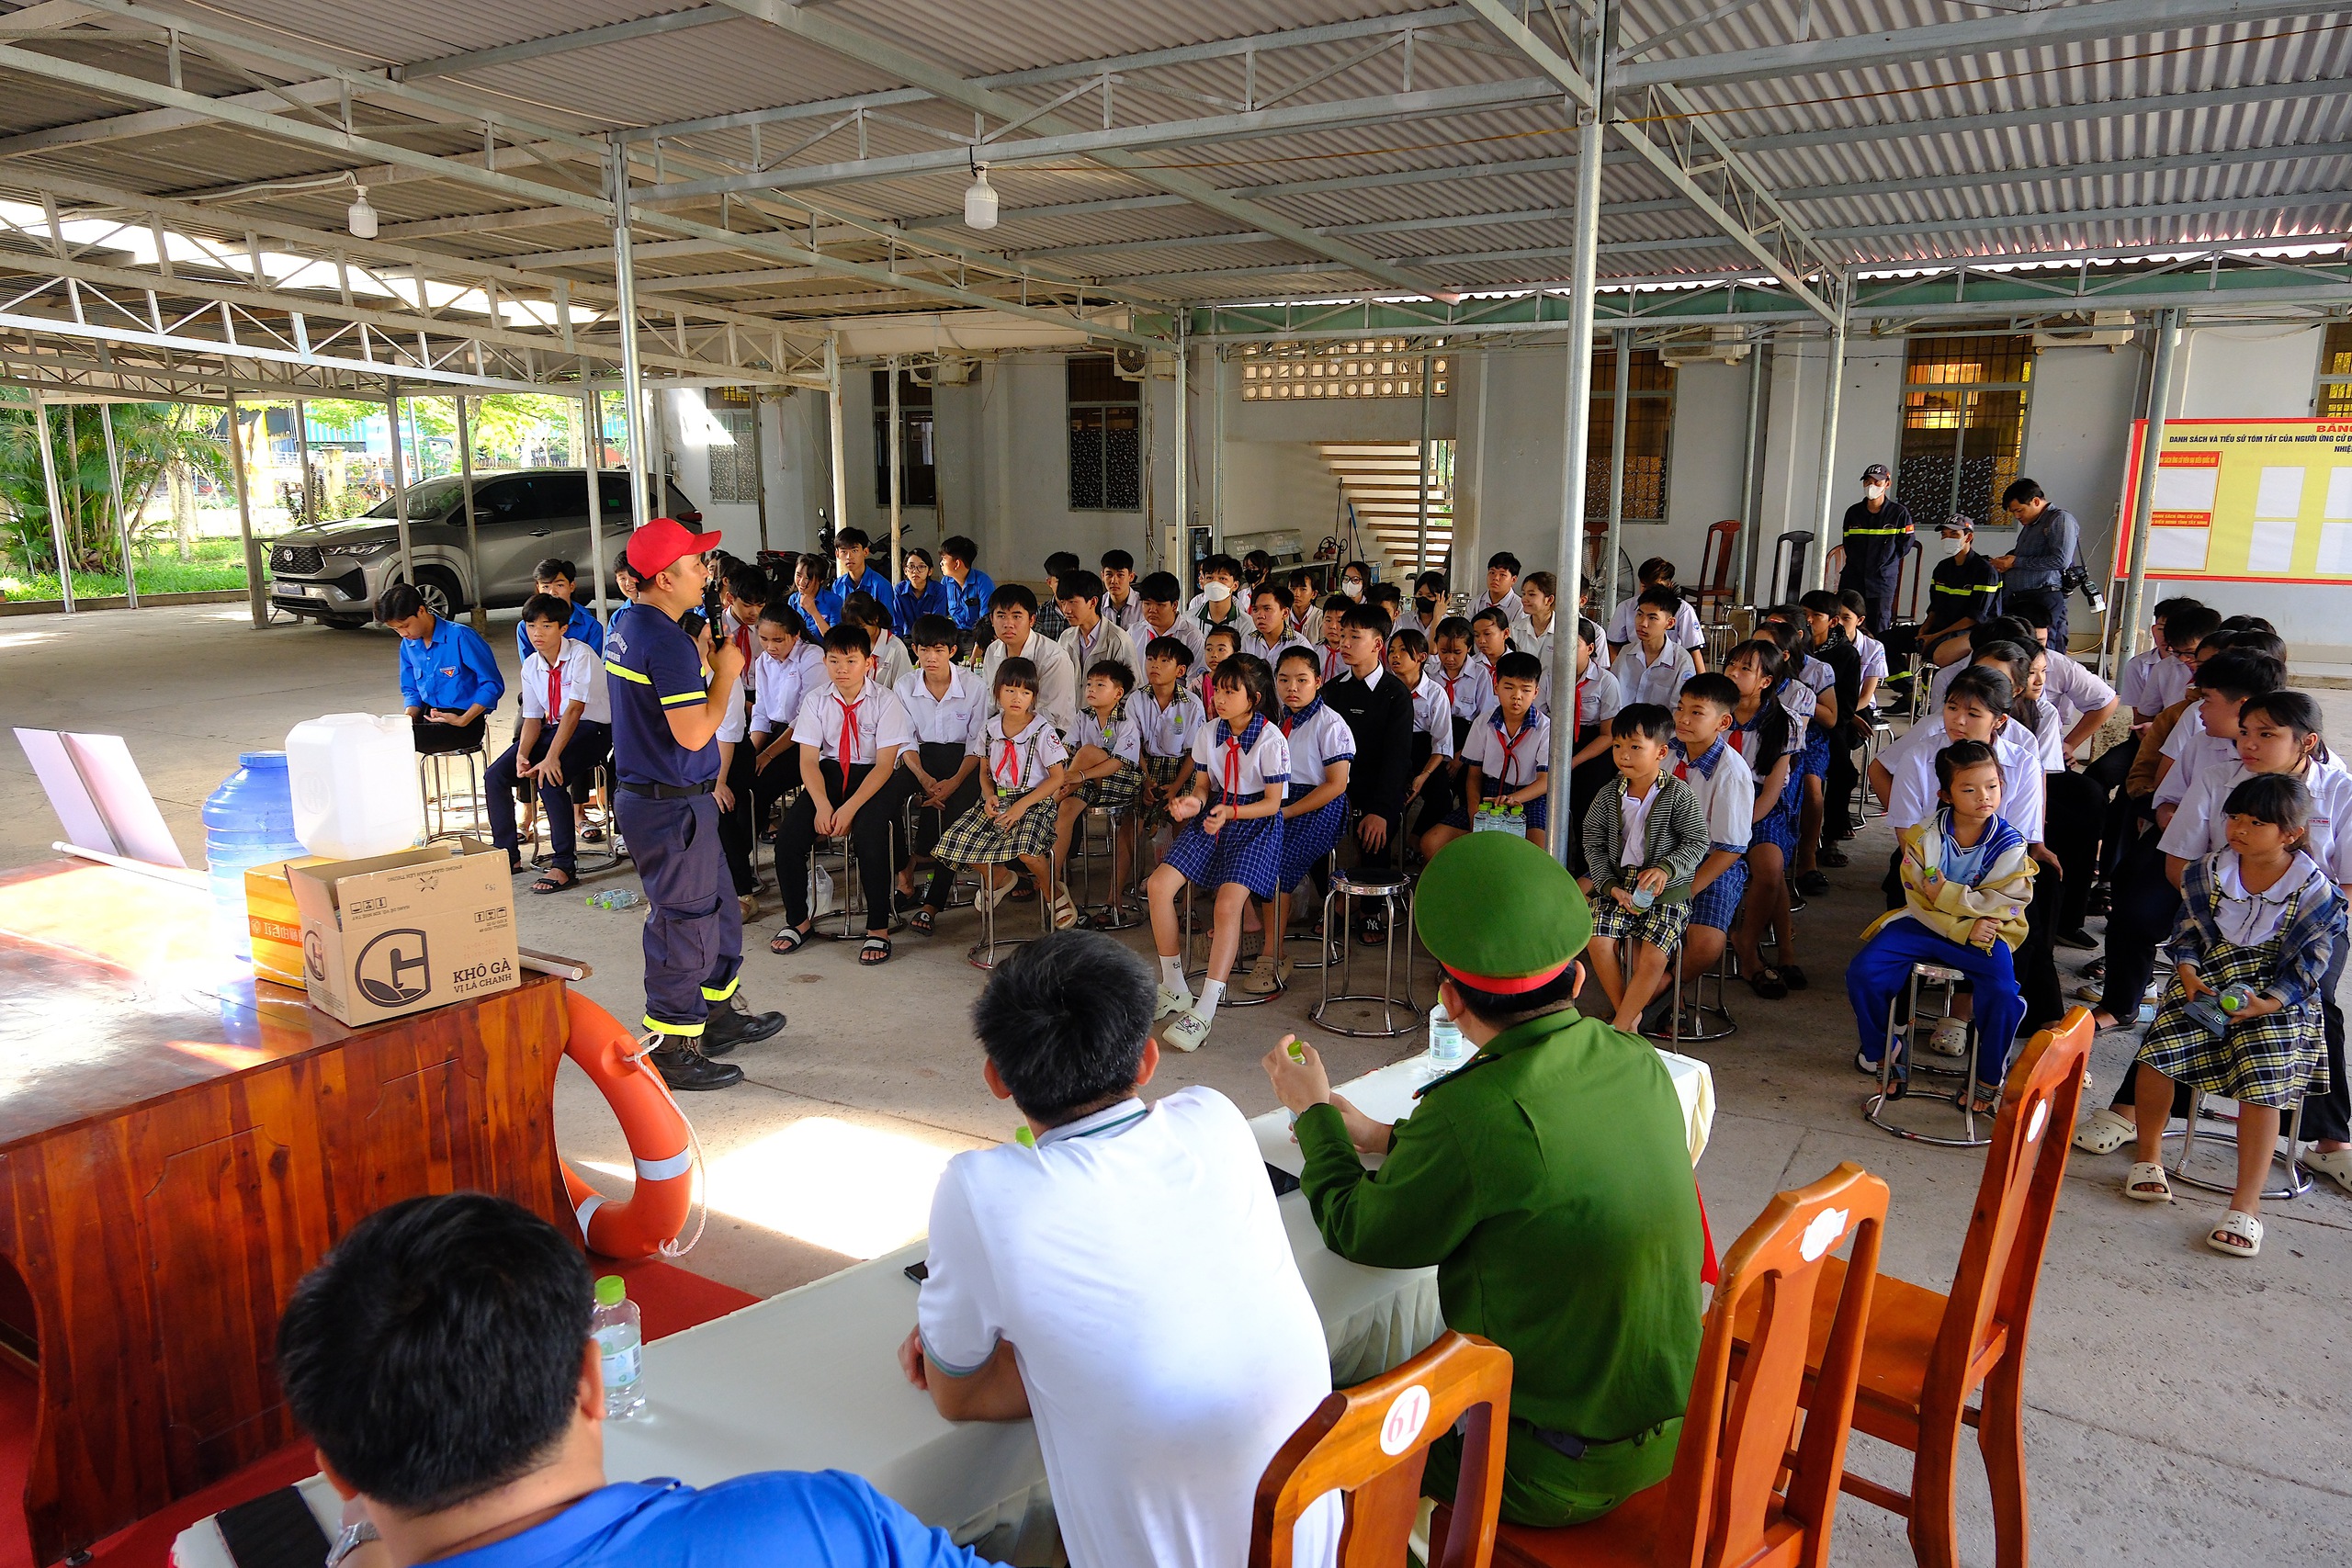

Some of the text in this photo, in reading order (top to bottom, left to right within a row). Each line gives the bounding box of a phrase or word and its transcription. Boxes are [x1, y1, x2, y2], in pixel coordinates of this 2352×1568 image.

[2189, 434, 2208, 443] SÁCH
[2209, 434, 2218, 443] VÀ
[2247, 434, 2263, 442] TÓM
[2278, 434, 2293, 442] CỦA
[2294, 434, 2317, 442] NGƯỜI
[2319, 434, 2334, 442] ỨNG
[2334, 445, 2352, 454] NHIỆ
[453, 957, 512, 983] KHÔ GÀ
[454, 973, 512, 993] VỊ LÁ CHANH
[1387, 1394, 1420, 1443] 61
